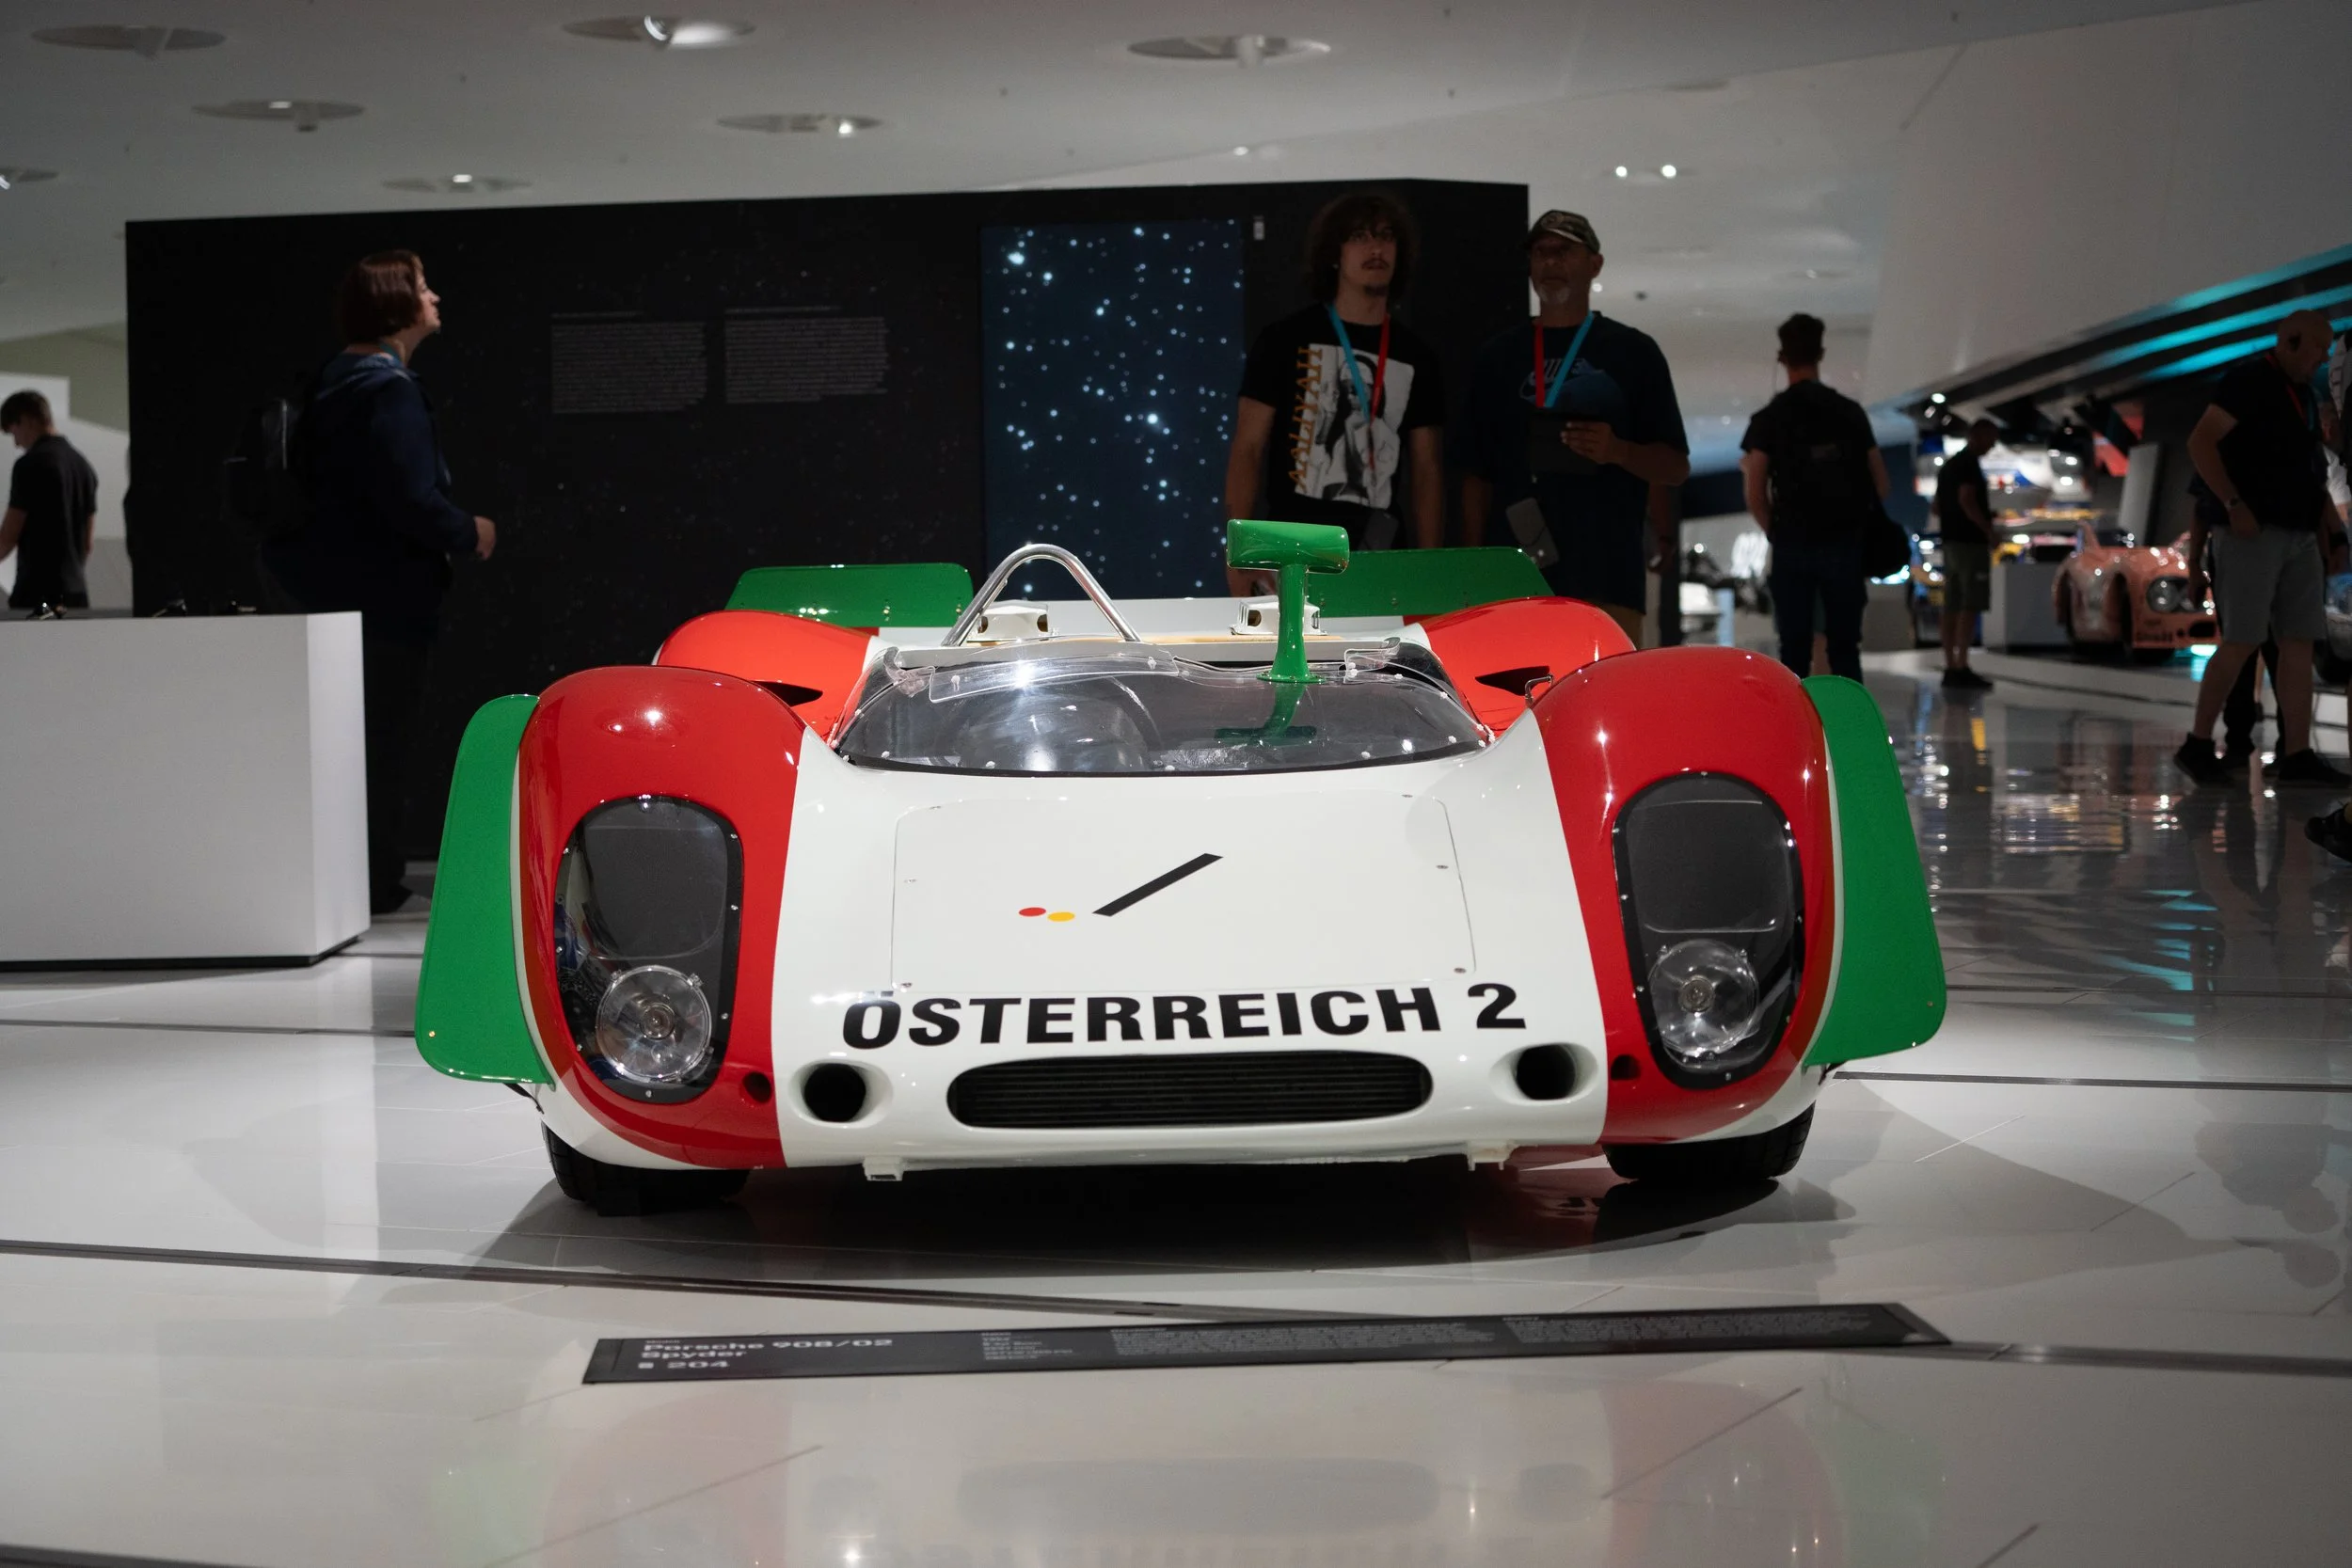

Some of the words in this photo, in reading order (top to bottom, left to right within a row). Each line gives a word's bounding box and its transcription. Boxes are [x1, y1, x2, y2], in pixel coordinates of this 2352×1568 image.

[1286, 344, 1323, 495] AALIYAH
[843, 988, 1440, 1050] ÖSTERREICH
[1468, 983, 1526, 1029] 2
[642, 1351, 747, 1359] Spyder
[644, 1342, 764, 1352] Porsche
[772, 1338, 894, 1349] 908/02
